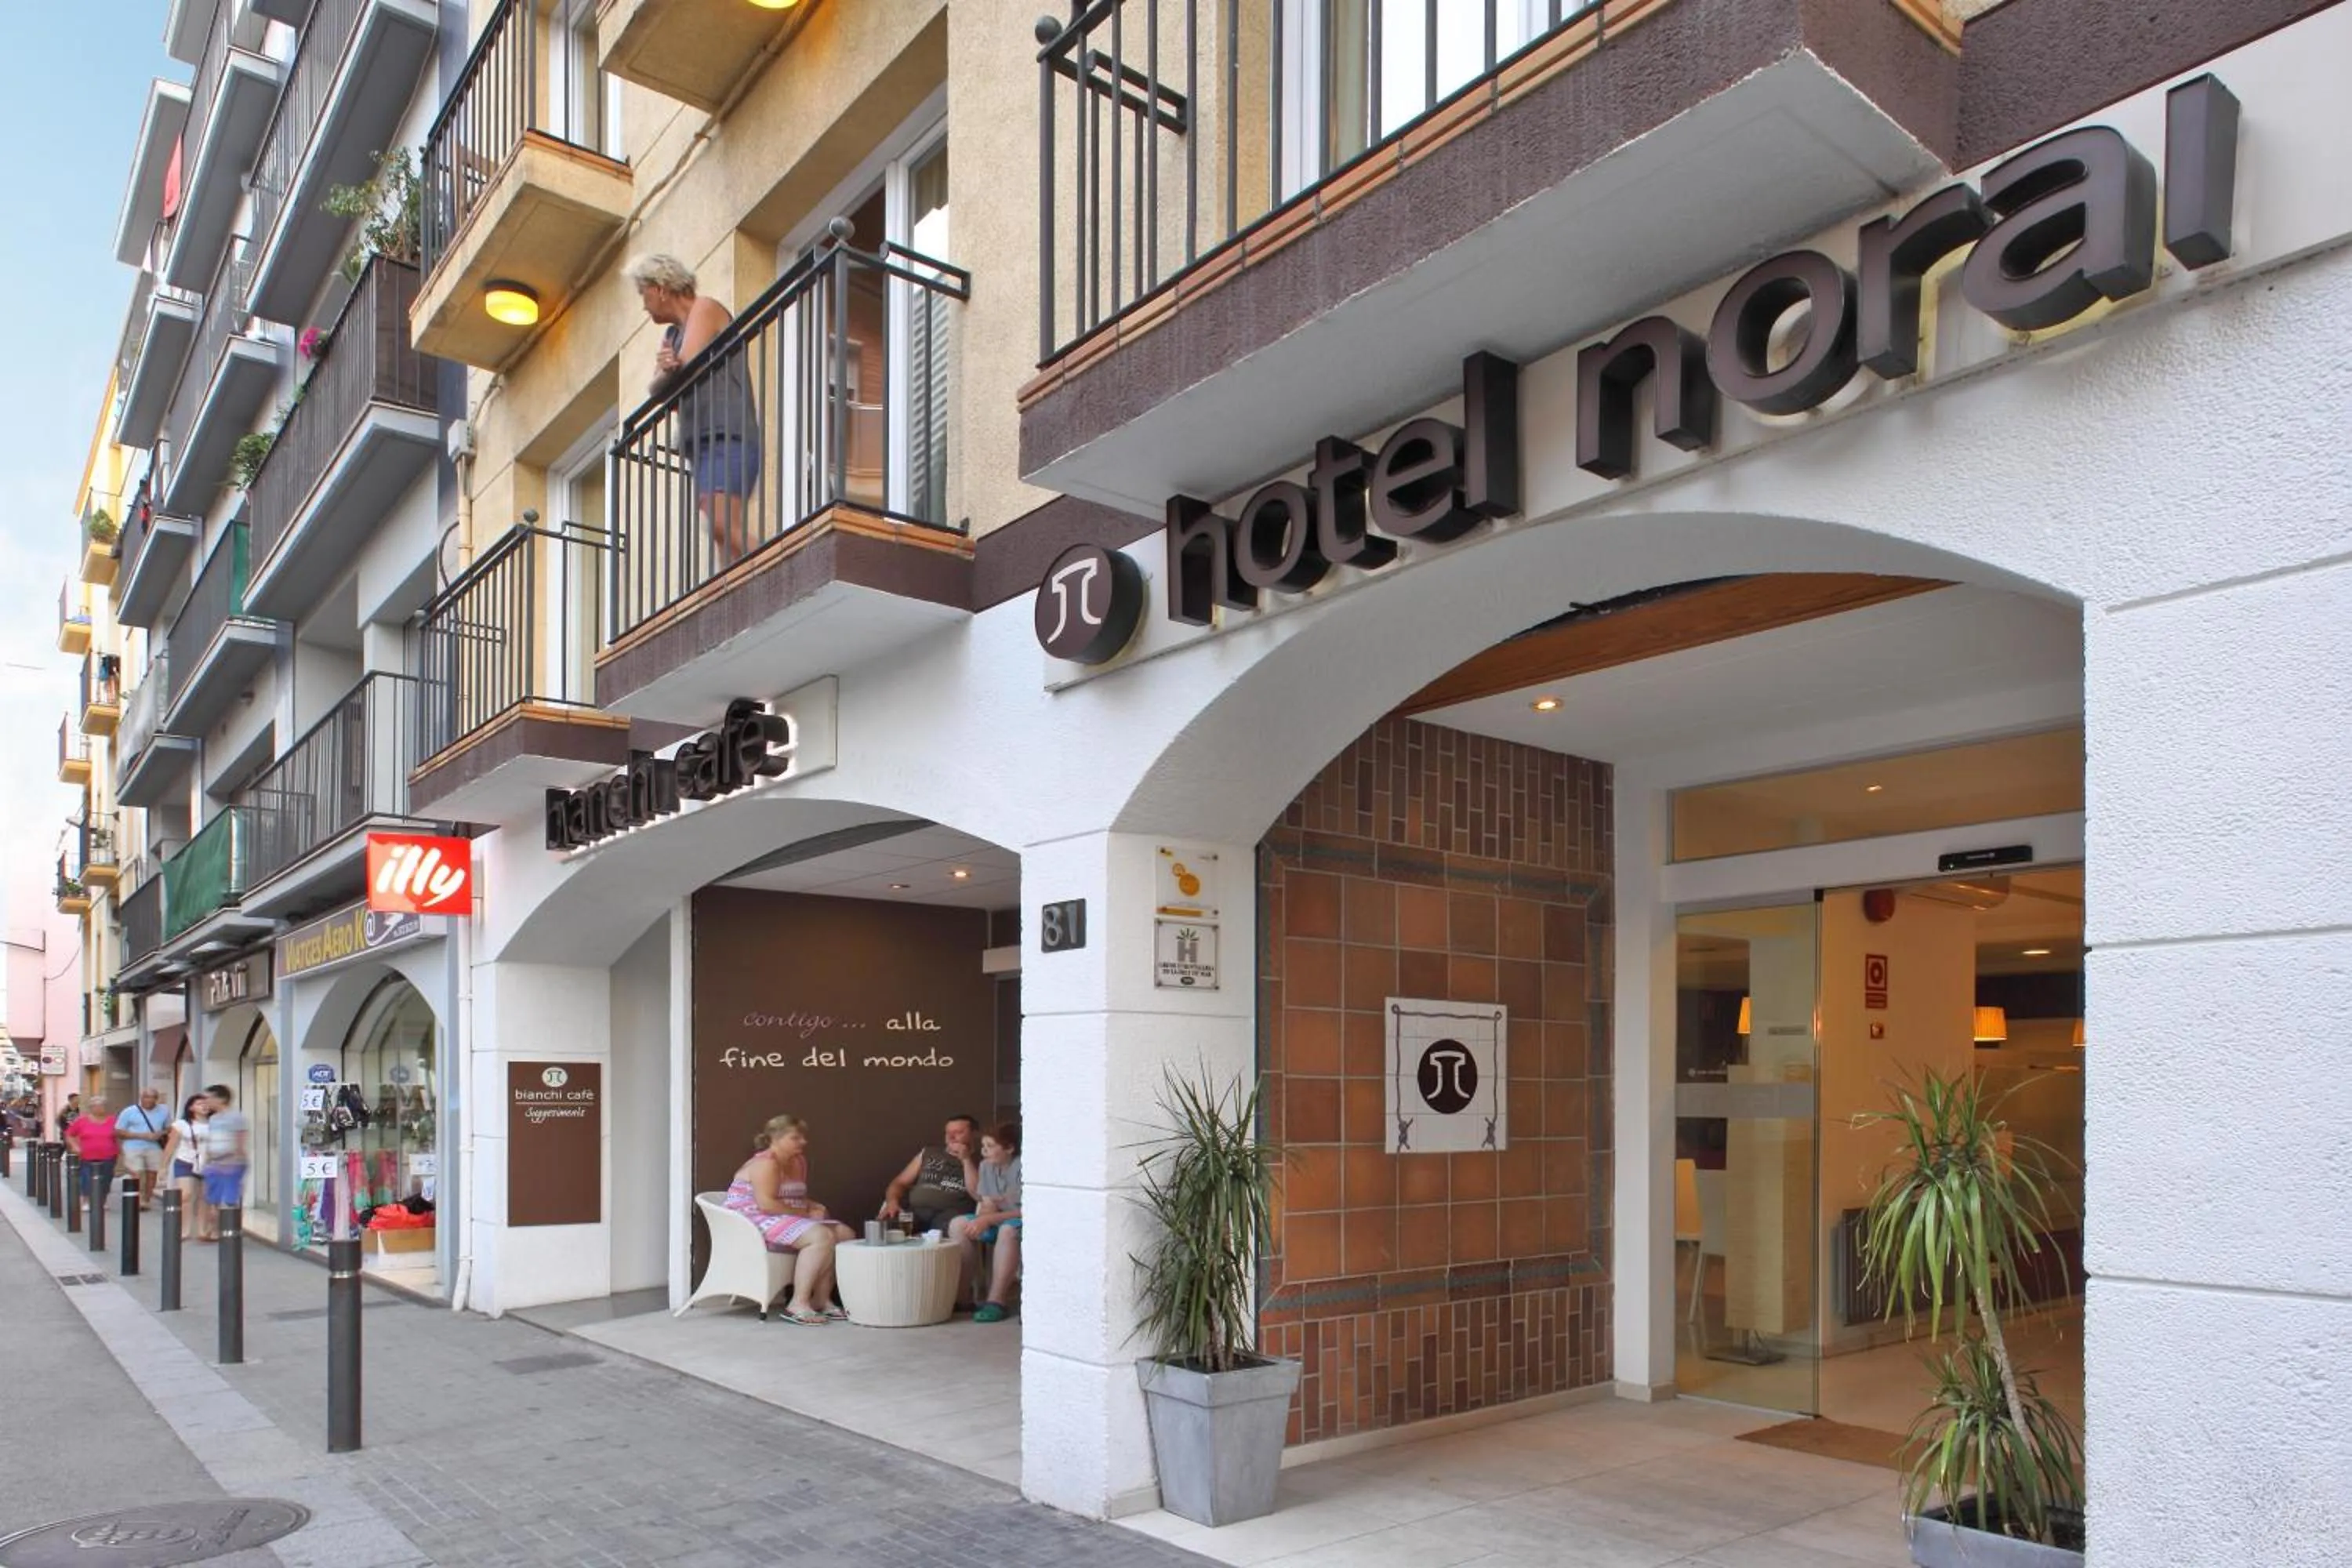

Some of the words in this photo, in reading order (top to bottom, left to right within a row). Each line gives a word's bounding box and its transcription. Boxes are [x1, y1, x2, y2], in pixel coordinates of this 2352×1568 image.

[1167, 350, 1521, 626] hotel
[1576, 72, 2241, 480] noral
[376, 844, 465, 907] illy
[1044, 904, 1078, 947] 81
[887, 1011, 941, 1030] alla
[719, 1046, 784, 1069] fine
[801, 1046, 845, 1067] del
[863, 1047, 953, 1067] mondo
[515, 1088, 562, 1100] bianchi
